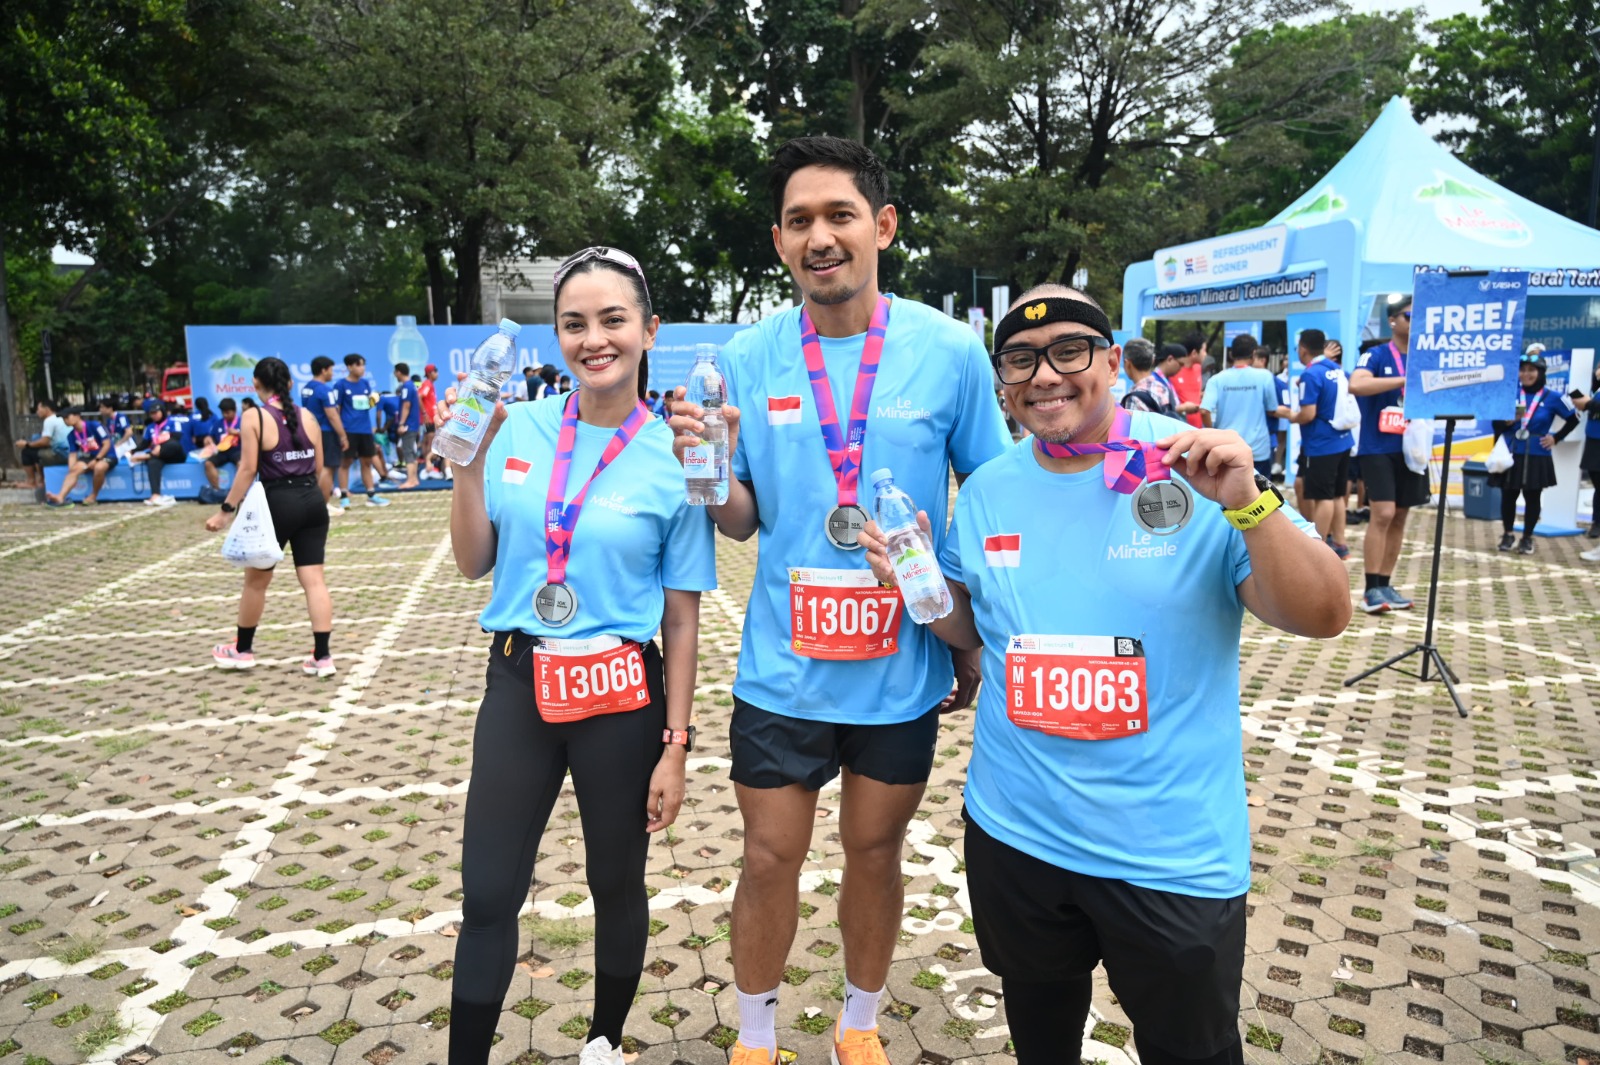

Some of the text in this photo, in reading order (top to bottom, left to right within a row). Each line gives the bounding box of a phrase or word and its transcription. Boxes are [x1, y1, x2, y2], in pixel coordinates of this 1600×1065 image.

[1212, 238, 1278, 259] REFRESHMENT
[1212, 260, 1248, 275] CORNER
[1153, 273, 1316, 310] Kebaikan Mineral Terlindungi
[1492, 281, 1521, 289] TAISHO
[1425, 300, 1518, 334] FREE!
[1416, 333, 1513, 350] MASSAGE
[1439, 351, 1487, 368] HERE
[231, 373, 245, 385] Le
[1442, 372, 1482, 383] Counterpain
[216, 383, 256, 393] Minera
[897, 396, 912, 409] Le
[460, 409, 469, 418] Le
[876, 406, 931, 420] Minerale
[689, 450, 696, 458] Le
[610, 491, 624, 503] Le
[589, 494, 637, 517] Minerale
[1132, 530, 1152, 546] Le
[1108, 542, 1177, 560] Minerale
[909, 563, 919, 571] Le
[794, 585, 805, 593] 10K
[794, 594, 803, 611] M
[796, 616, 804, 632] B
[807, 596, 899, 636] 13067
[539, 655, 551, 663] 10K
[1012, 655, 1027, 663] 10K
[541, 664, 548, 680] F
[554, 650, 643, 701] 13066
[1012, 665, 1025, 684] M
[542, 684, 550, 700] B
[1031, 666, 1140, 713] 13063
[1014, 689, 1024, 708] B
